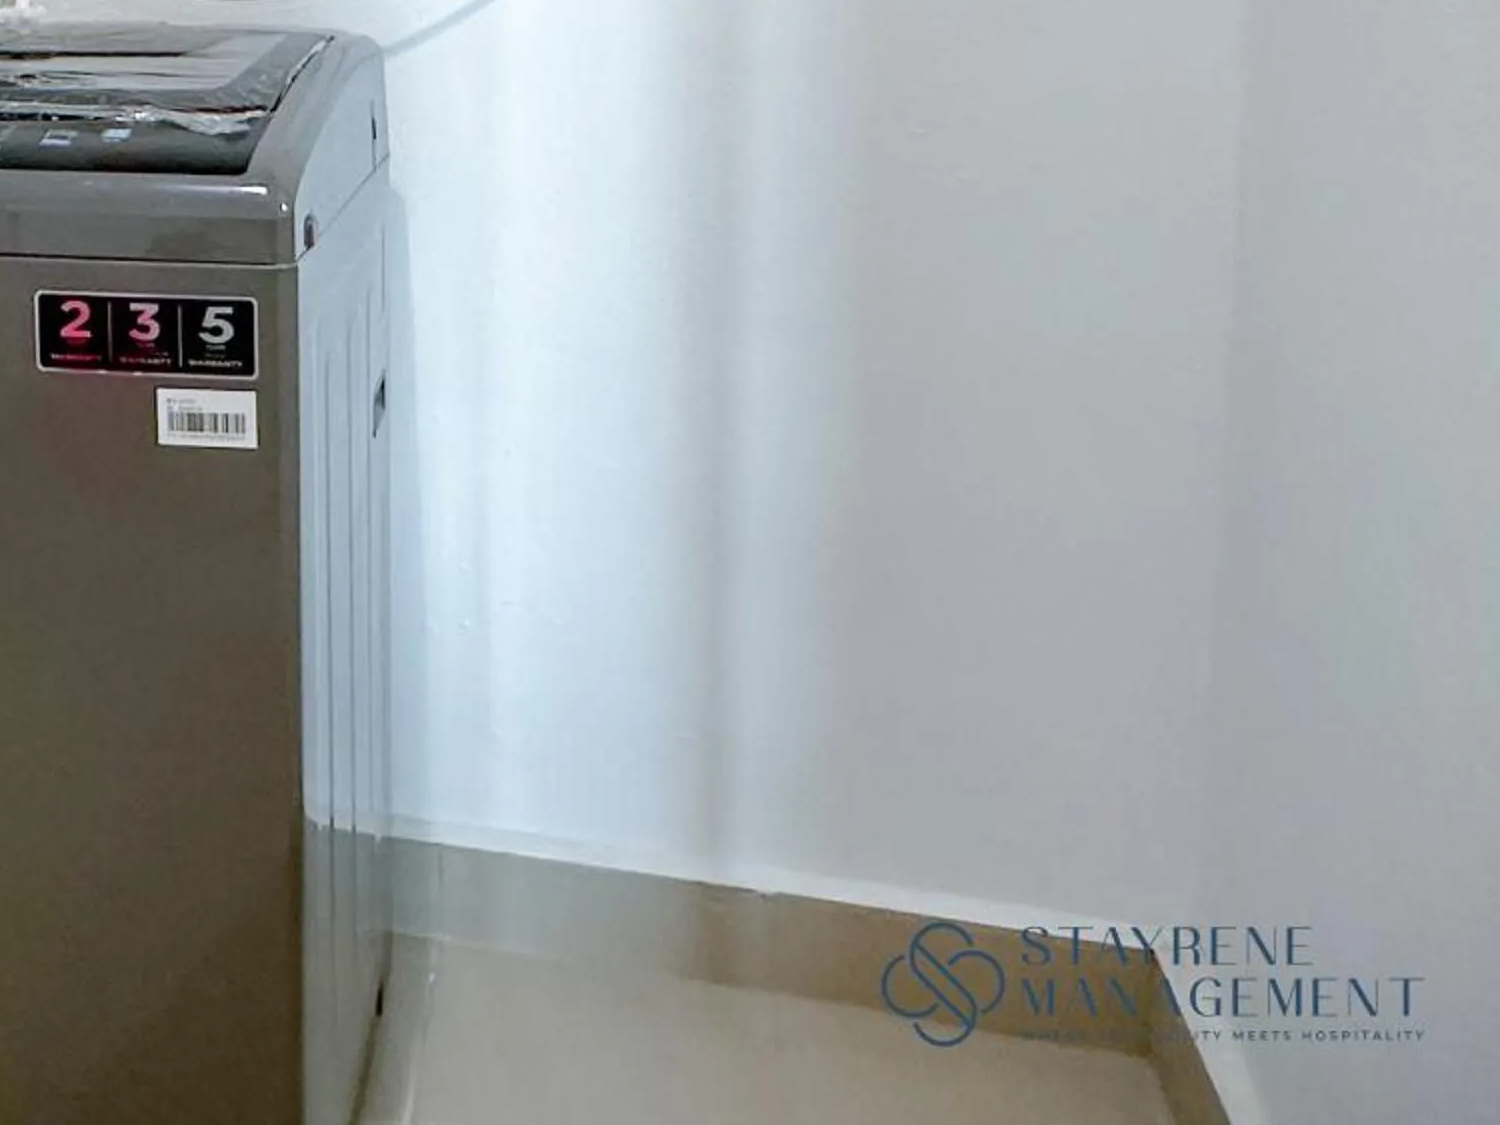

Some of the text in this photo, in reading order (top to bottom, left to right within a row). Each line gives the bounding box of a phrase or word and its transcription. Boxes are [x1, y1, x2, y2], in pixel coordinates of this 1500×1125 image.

[60, 300, 92, 338] 2
[129, 302, 161, 341] 3
[198, 306, 234, 344] 5
